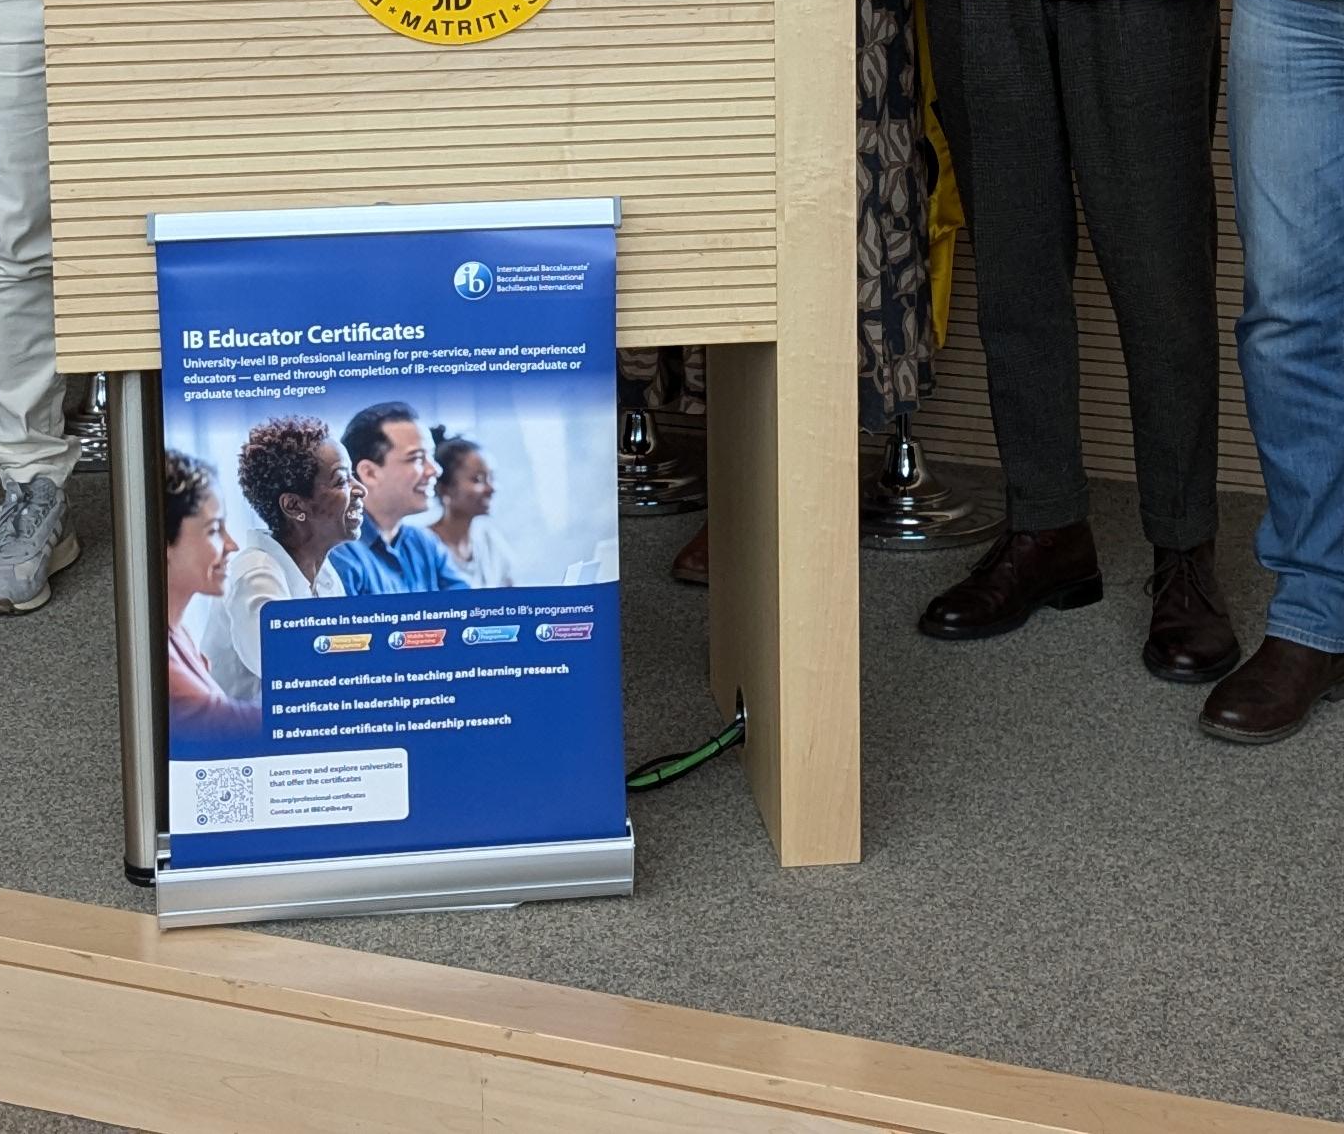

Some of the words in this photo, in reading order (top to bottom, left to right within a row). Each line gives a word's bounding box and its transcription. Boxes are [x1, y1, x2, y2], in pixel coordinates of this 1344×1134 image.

[400, 8, 508, 36] MATRITI
[496, 264, 540, 273] International
[541, 273, 585, 281] International
[182, 330, 204, 349] IB
[208, 328, 303, 348] Educator
[307, 322, 425, 344] Certificates
[183, 355, 266, 370] University-level
[268, 355, 278, 365] IB
[281, 351, 345, 366] professional
[347, 349, 391, 363] learning
[394, 348, 408, 360] for
[411, 346, 472, 361] pre-service,
[474, 347, 497, 357] new
[498, 344, 519, 356] and
[521, 343, 586, 357] experienced
[183, 372, 236, 384] educators
[253, 369, 291, 382] earned
[294, 366, 336, 381] through
[339, 364, 399, 378] completion
[401, 364, 414, 375] of
[414, 361, 487, 374] IB-recognized
[489, 359, 568, 373] undergraduate
[570, 360, 582, 370] or
[184, 387, 232, 401] graduate
[234, 384, 281, 399] teaching
[283, 382, 326, 397] degrees
[270, 619, 281, 629] IB
[283, 616, 337, 629] certificate
[339, 614, 350, 625] in
[352, 612, 398, 625] teaching
[400, 610, 421, 621] and
[422, 608, 467, 620] learning
[469, 606, 504, 619] aligned
[506, 606, 516, 615] to
[535, 604, 594, 617] programmes
[271, 680, 283, 690] IB
[284, 676, 337, 689] advanced
[338, 673, 392, 686] certificate
[394, 672, 405, 682] in
[407, 669, 453, 682] teaching
[455, 667, 476, 678] and
[477, 665, 522, 677] learning
[523, 663, 569, 675] research
[272, 704, 284, 714] IB
[285, 701, 339, 713] certificate
[341, 699, 352, 710] in
[354, 696, 411, 709] leadership
[412, 693, 455, 708] practice
[272, 729, 284, 739] IB
[285, 725, 338, 738] advanced
[339, 722, 394, 735] certificate
[395, 721, 406, 732] in
[407, 717, 464, 731] leadership
[466, 714, 512, 727] research
[269, 768, 291, 777] Learn
[291, 767, 312, 775] more
[313, 765, 329, 774] and
[329, 764, 359, 774] explore
[359, 762, 403, 771] universities
[269, 779, 285, 787] that
[286, 778, 304, 786] offer
[306, 777, 319, 785] the
[320, 775, 362, 785] certificates
[270, 808, 294, 816] Contact
